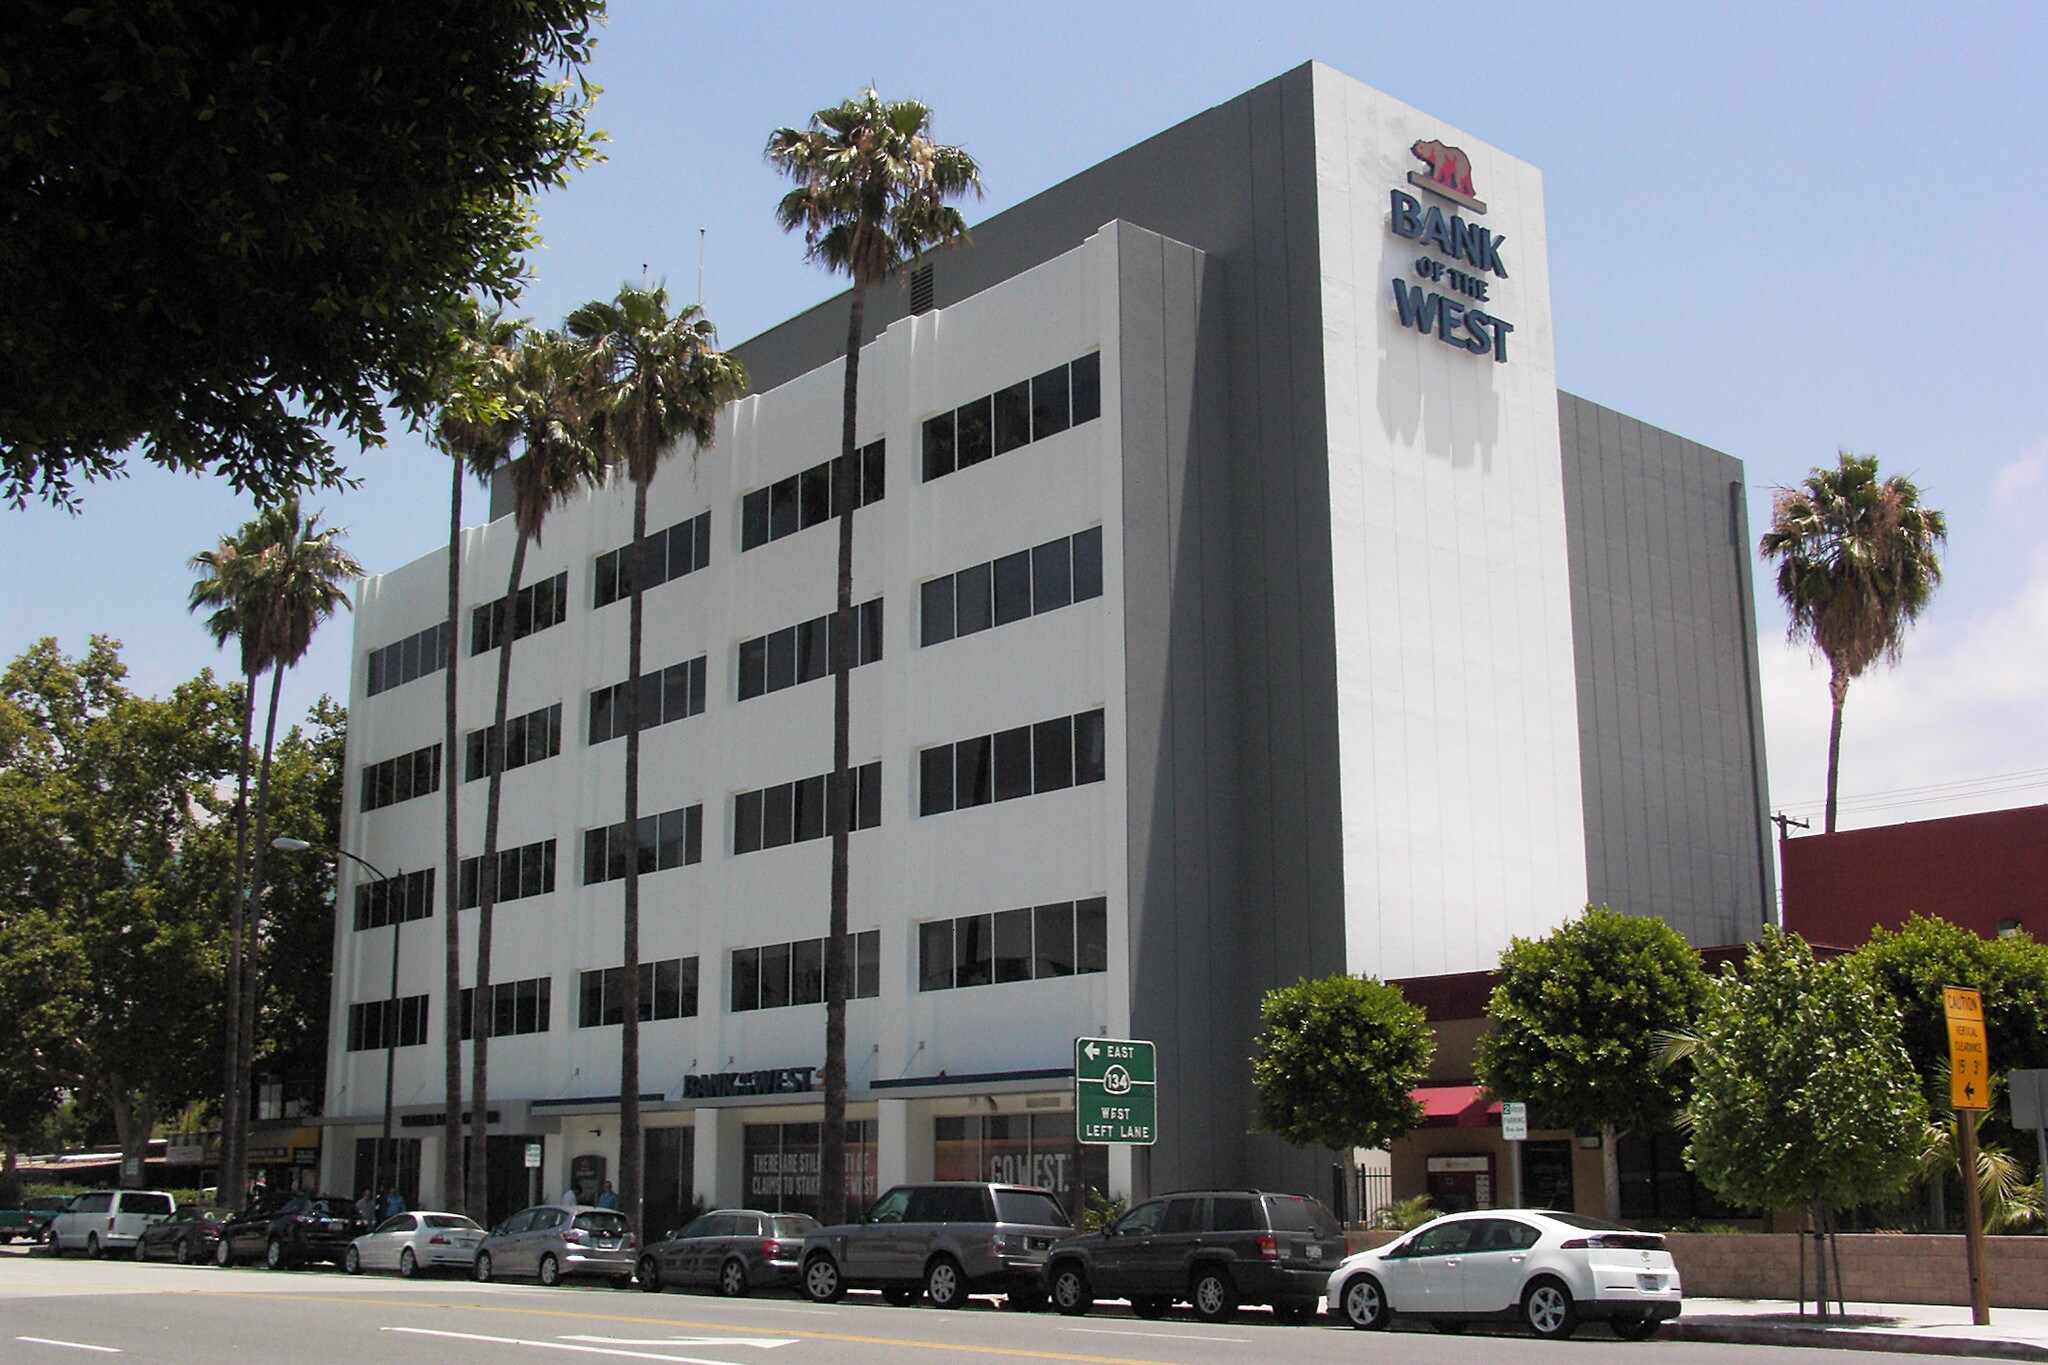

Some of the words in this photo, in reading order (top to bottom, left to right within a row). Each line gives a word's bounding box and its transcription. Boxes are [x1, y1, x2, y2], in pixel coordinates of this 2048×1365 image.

[1391, 189, 1509, 279] BANK
[1415, 256, 1446, 282] OF
[1447, 268, 1489, 301] THE
[1392, 277, 1514, 363] WEST
[1107, 1045, 1134, 1058] EAST
[752, 1067, 816, 1096] WEST
[1107, 1073, 1128, 1089] 134
[1101, 1107, 1130, 1120] WEST
[1503, 1103, 1510, 1114] 2
[1086, 1124, 1114, 1137] LEFT
[1120, 1125, 1150, 1138] LANE
[991, 1154, 1014, 1183] GO
